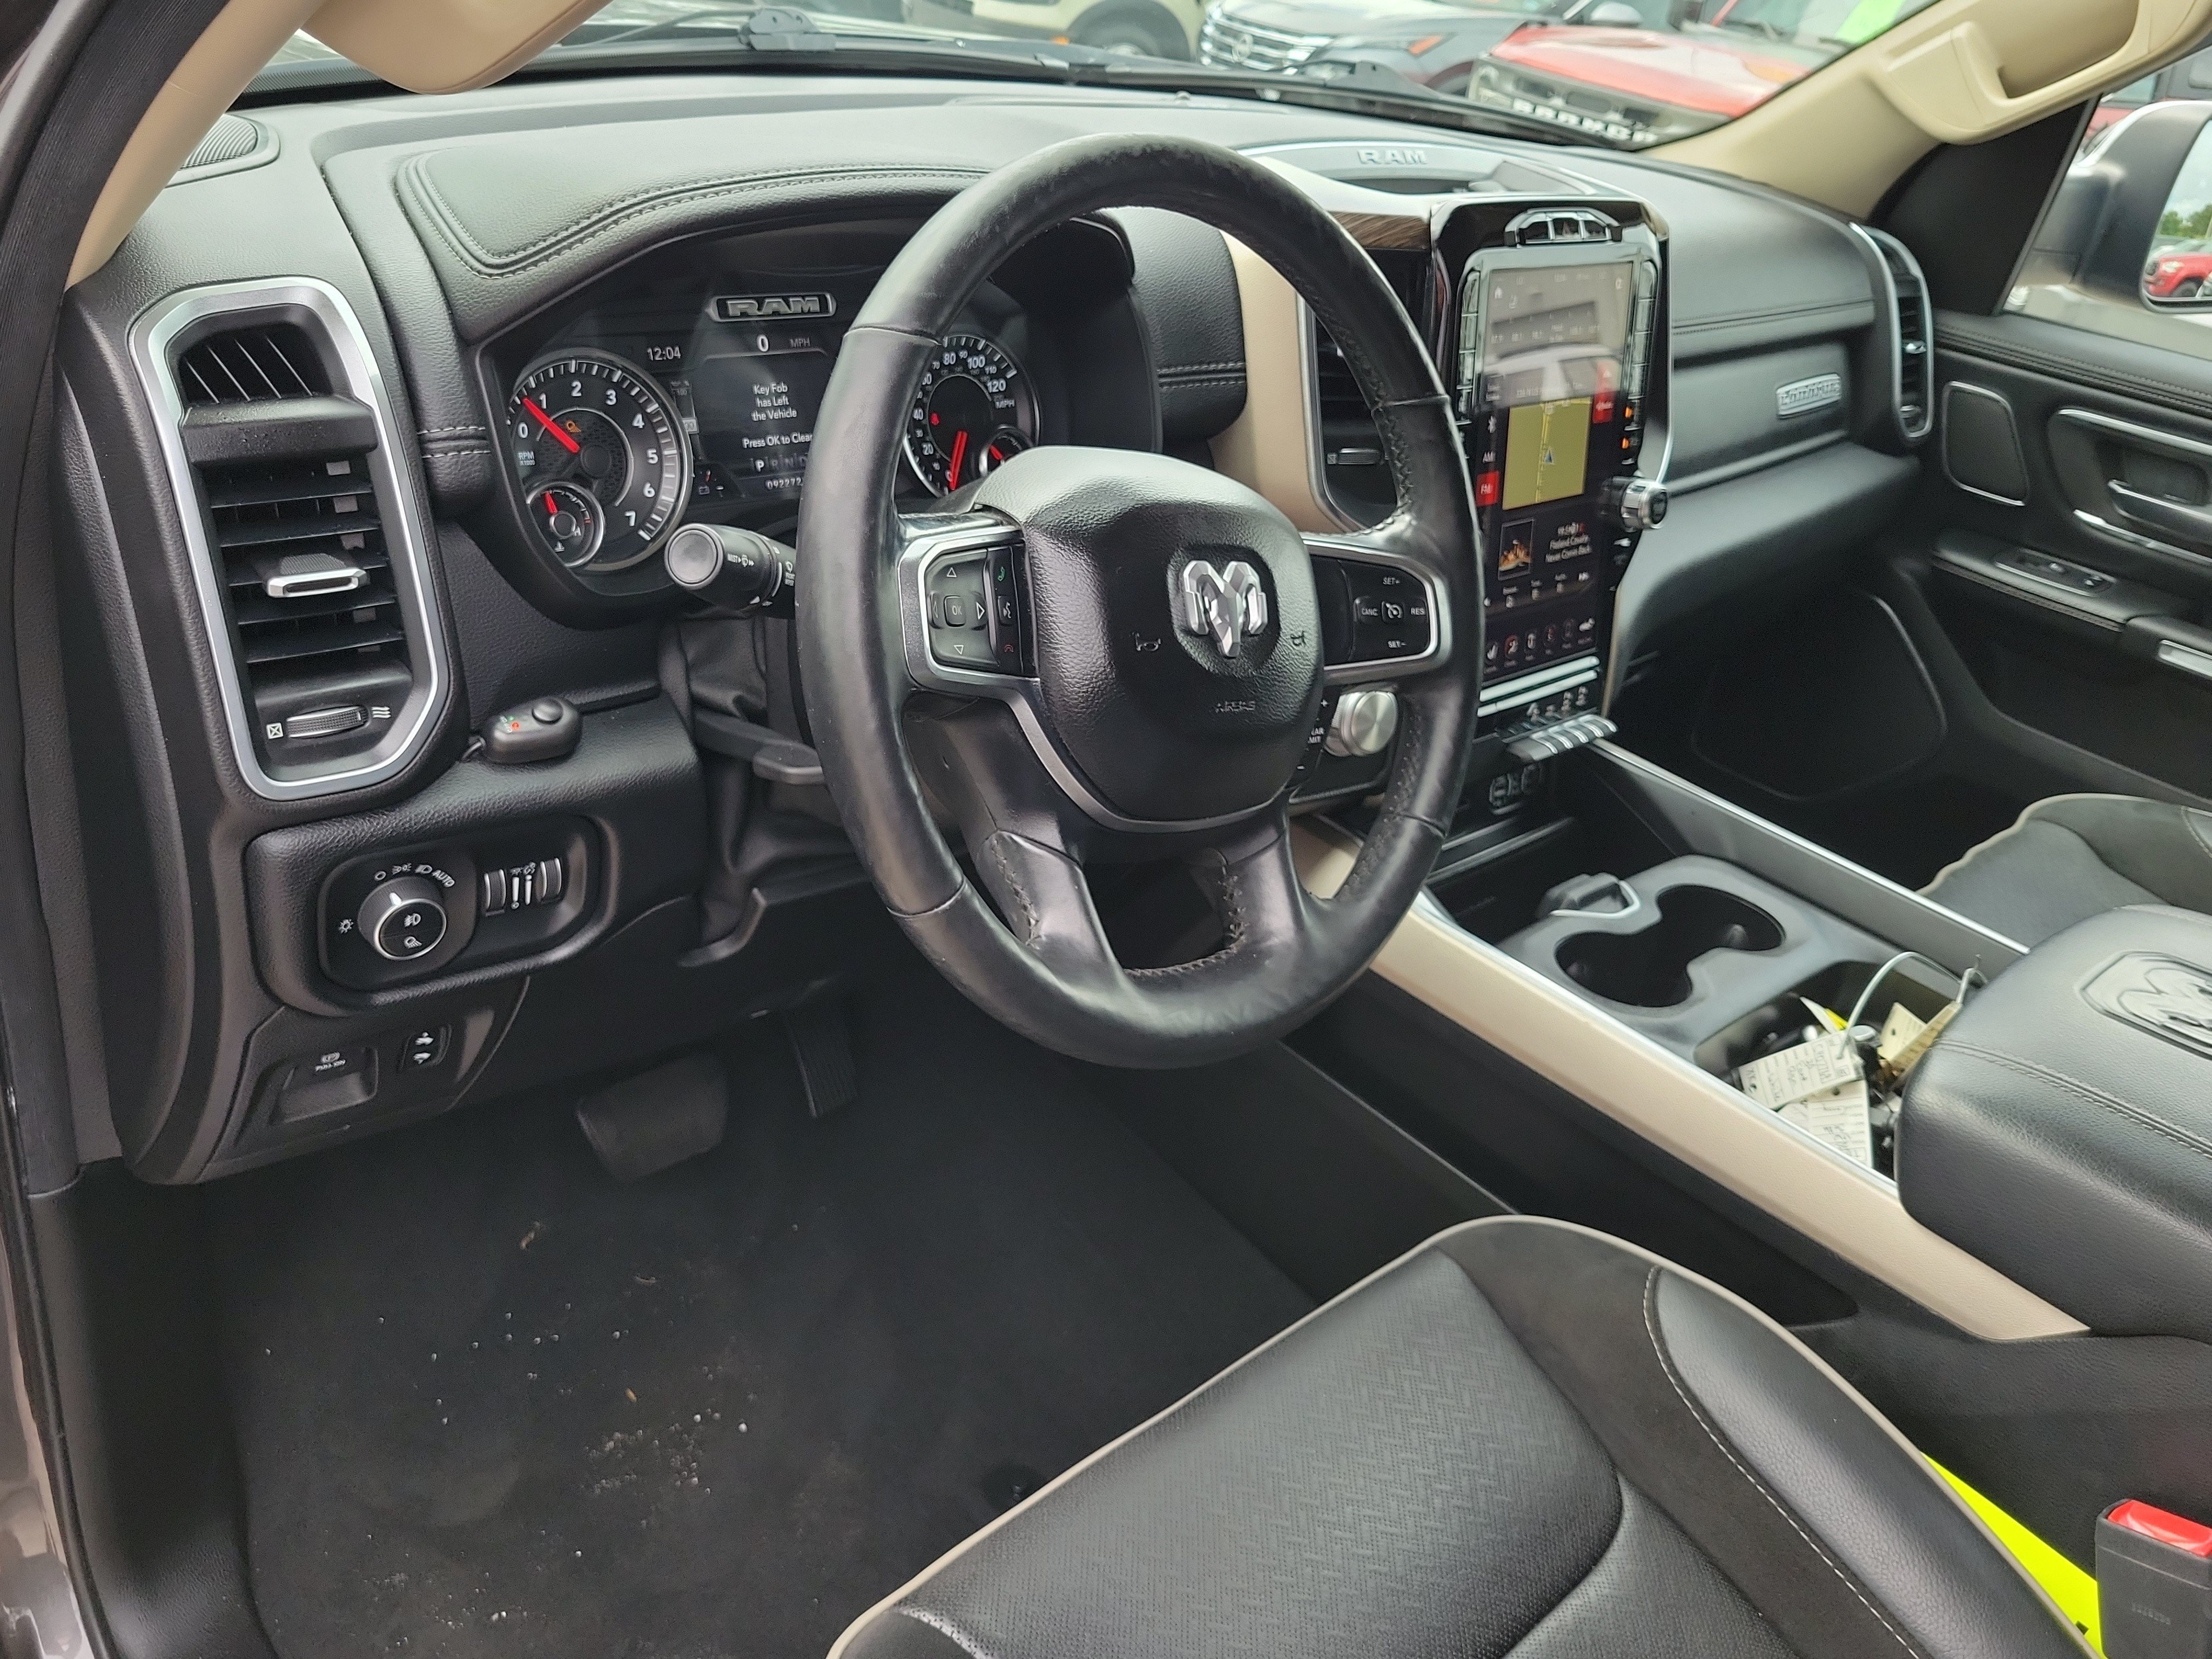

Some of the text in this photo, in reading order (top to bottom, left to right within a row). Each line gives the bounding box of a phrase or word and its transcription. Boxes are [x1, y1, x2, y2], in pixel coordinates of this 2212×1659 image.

[1357, 149, 1427, 165] RAM
[727, 297, 820, 317] RAM
[757, 335, 811, 352] 0 MPH
[647, 346, 681, 360] 12:04
[943, 352, 956, 365] 80
[967, 354, 985, 369] 100
[572, 381, 582, 396] 2
[753, 382, 788, 395] Key Fob
[988, 378, 1006, 393] 120
[539, 393, 547, 409] 1
[606, 389, 617, 405] 3
[757, 395, 789, 407] has Left
[995, 399, 1015, 408] MPH
[633, 413, 645, 428] 4
[751, 409, 797, 421] the Vehicle
[913, 408, 923, 420] 40
[518, 422, 528, 438] 0
[742, 437, 766, 448] Press
[766, 435, 781, 445] OK
[781, 435, 791, 444] to
[922, 442, 934, 455] 20
[518, 451, 535, 460] RPM
[647, 448, 658, 464] 5
[1483, 451, 1496, 463] AM
[755, 459, 765, 472] P
[644, 482, 655, 498] 6
[1481, 483, 1492, 494] FM
[625, 510, 636, 527] 7
[727, 554, 738, 563] MIST
[952, 605, 962, 616] OK
[1410, 607, 1426, 616] RES
[432, 869, 455, 888] AUTO
